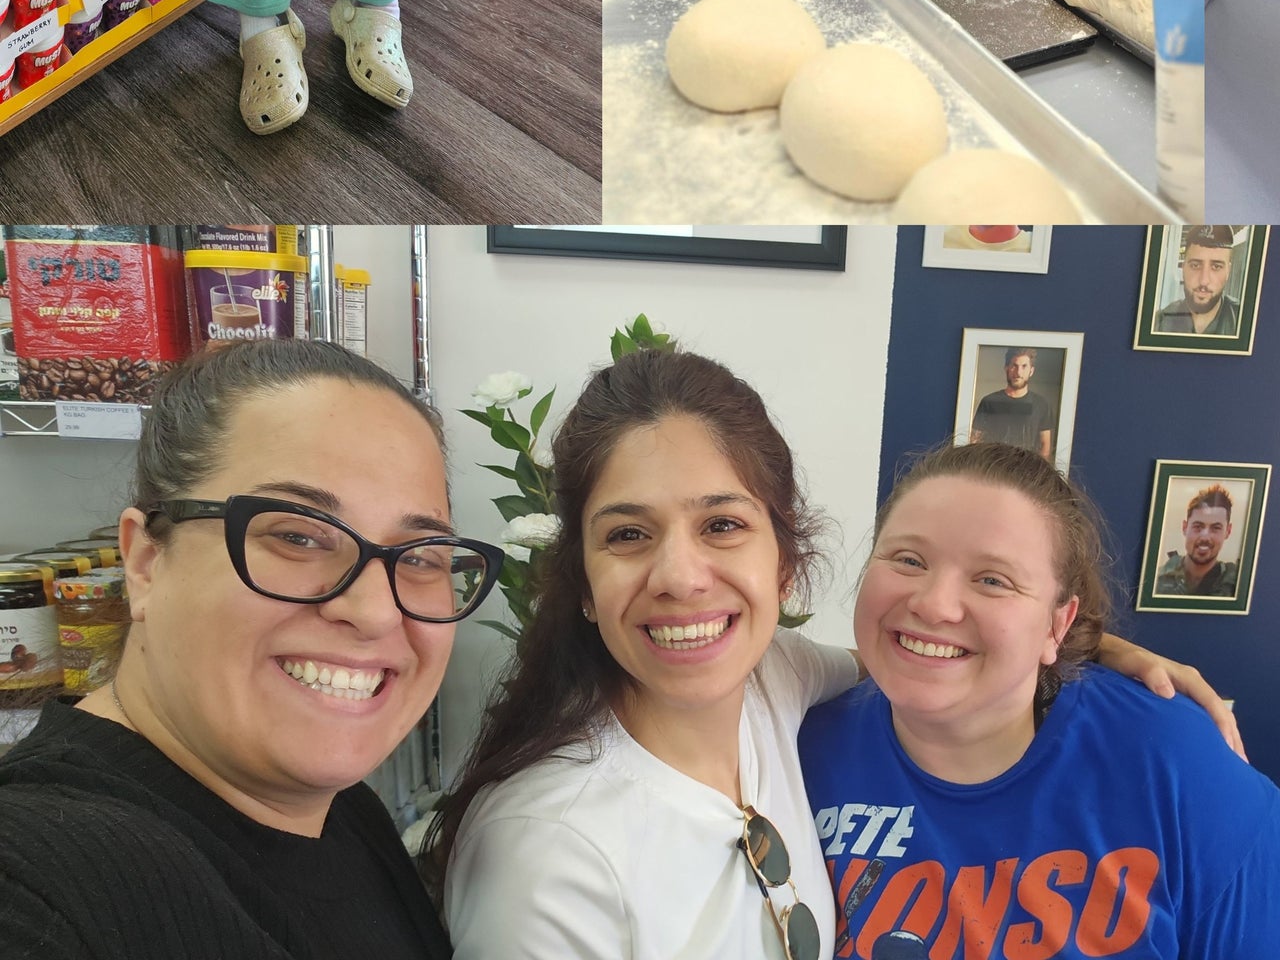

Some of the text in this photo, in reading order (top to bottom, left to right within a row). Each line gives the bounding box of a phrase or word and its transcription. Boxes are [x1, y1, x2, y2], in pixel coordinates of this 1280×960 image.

[8, 18, 52, 49] STRAWBERRY
[18, 38, 36, 53] GUM
[239, 233, 256, 242] Drink
[28, 256, 121, 287] טורקי
[207, 321, 276, 341] Chocolit
[814, 803, 916, 858] PETE
[827, 846, 1161, 960] LONSO
